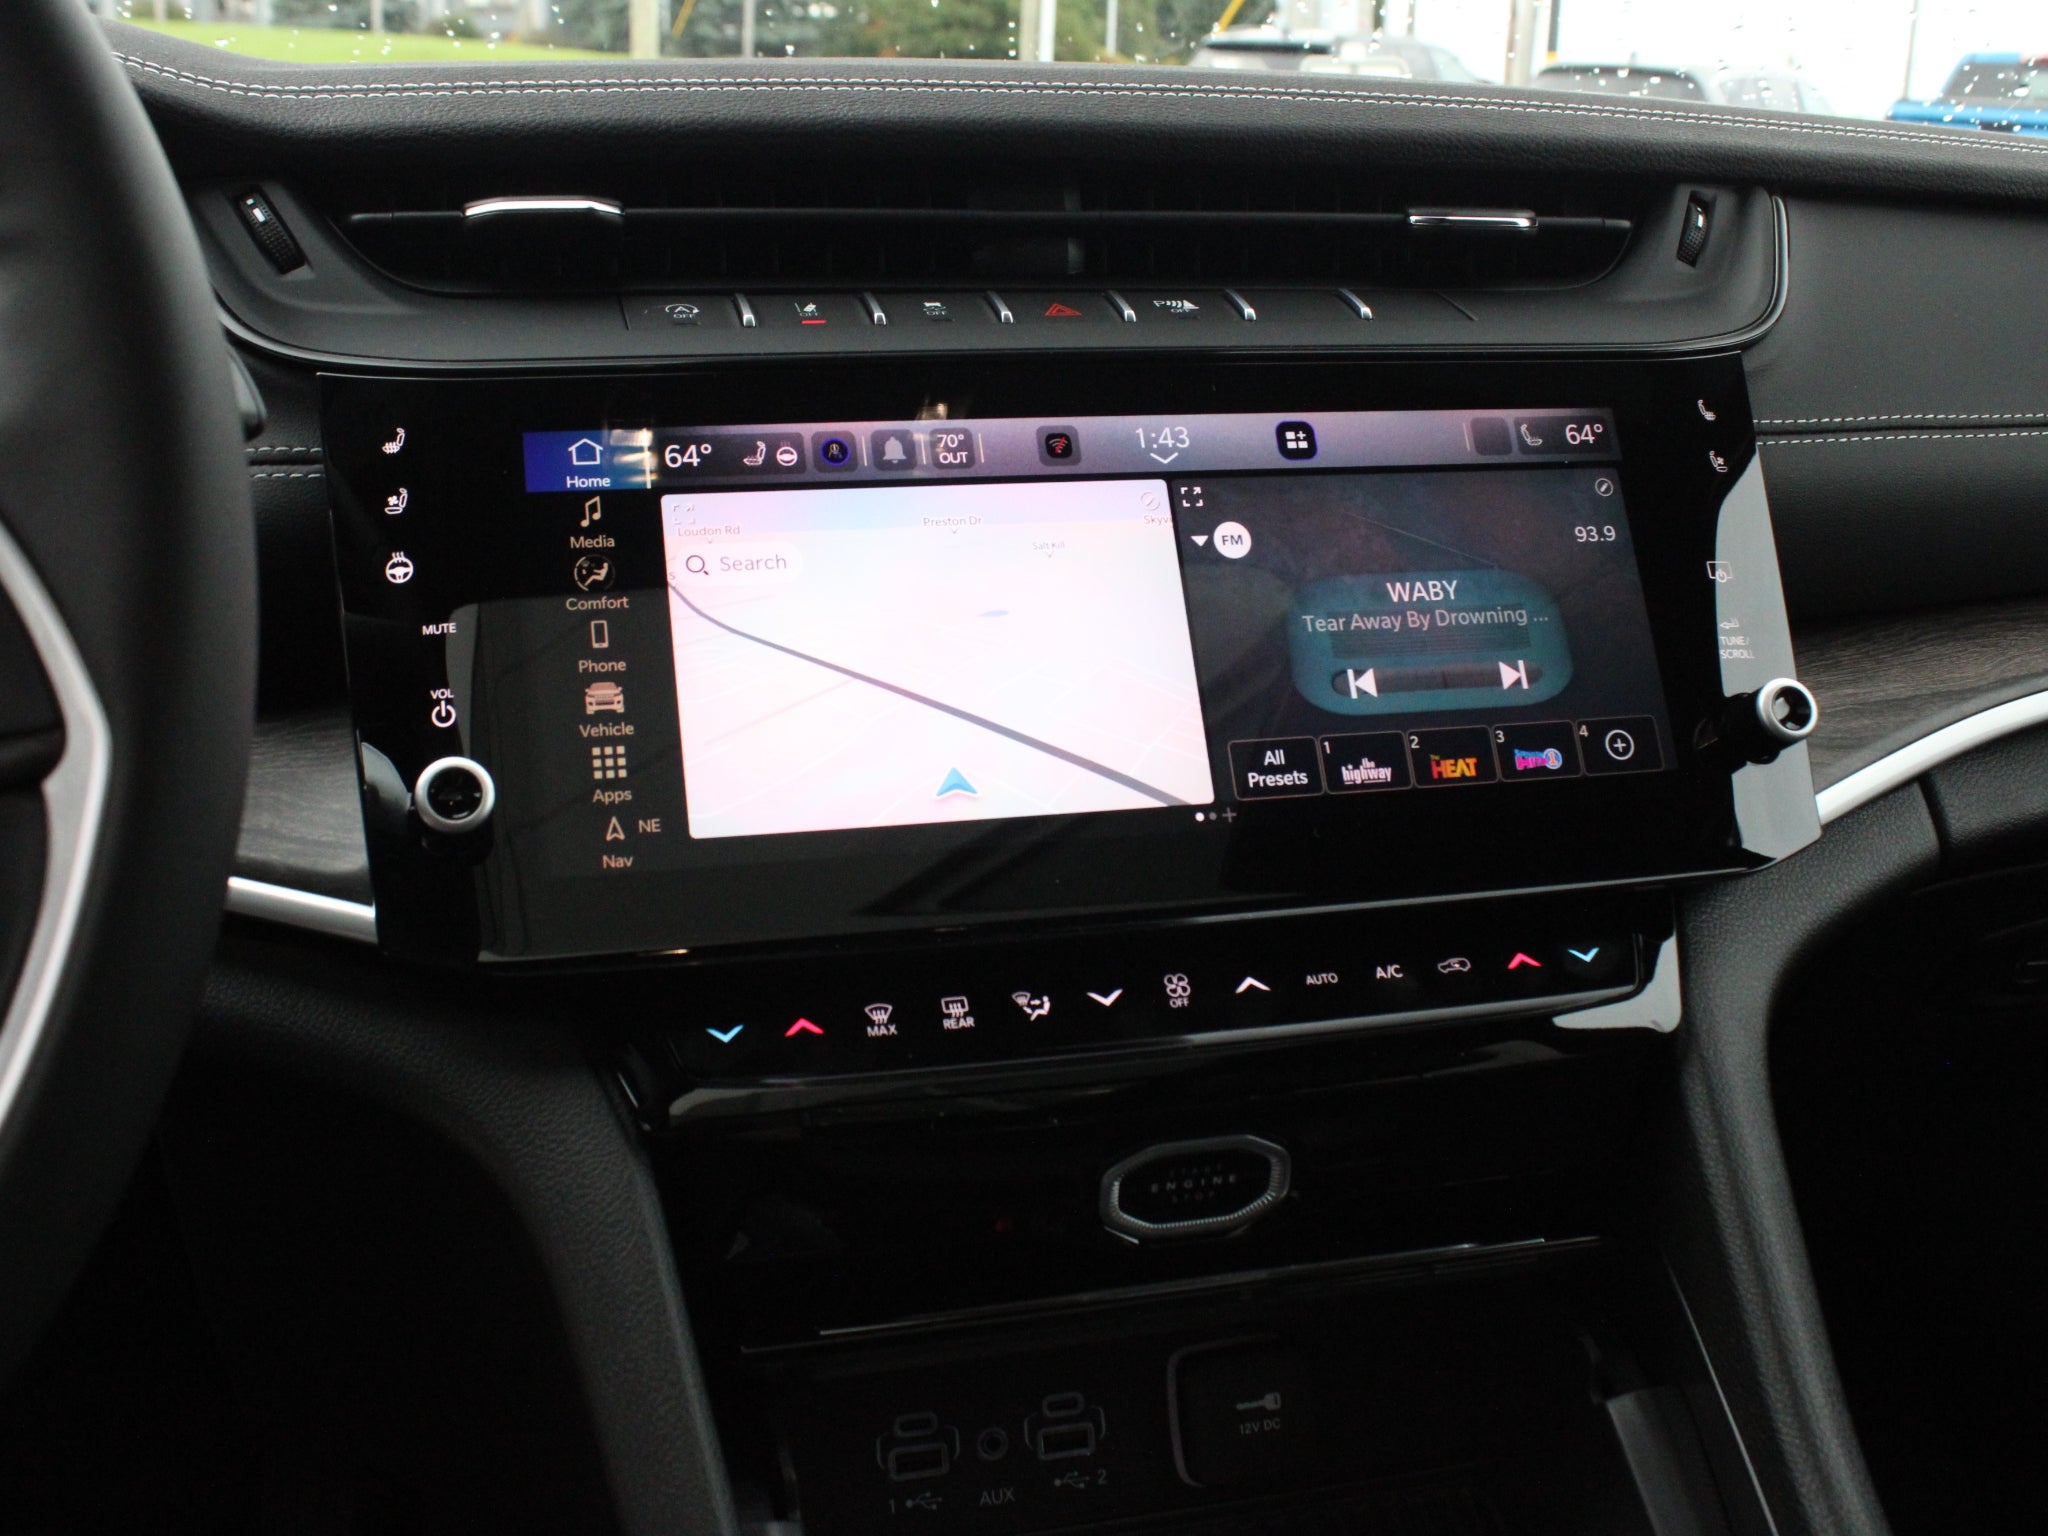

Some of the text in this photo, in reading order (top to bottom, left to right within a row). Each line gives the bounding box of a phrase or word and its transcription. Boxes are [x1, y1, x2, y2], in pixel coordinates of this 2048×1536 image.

[1136, 426, 1190, 449] 1:43
[939, 451, 968, 464] OUT
[566, 474, 611, 489] Home
[922, 515, 982, 527] Preston Dr
[678, 525, 741, 537] Loudon Rd
[1574, 525, 1616, 542] 93.9
[570, 534, 615, 549] Media
[1221, 534, 1243, 546] FM
[720, 555, 787, 572] Search
[1386, 580, 1458, 602] WABY
[566, 596, 629, 610] Comfort
[1302, 615, 1346, 632] Tear
[1350, 612, 1401, 632] Away
[1407, 611, 1430, 631] By
[1435, 607, 1528, 627] Drowning
[422, 622, 457, 636] MUTE
[1720, 649, 1755, 660] SCROLL
[578, 659, 627, 674] Phone
[430, 688, 454, 699] VOL
[579, 722, 634, 738] Vehicle
[1496, 730, 1505, 744] 3
[1579, 725, 1589, 738] 4
[1323, 741, 1331, 754] 1
[1410, 736, 1420, 749] 2
[1263, 749, 1286, 766] All
[1361, 757, 1375, 769] the
[1341, 763, 1392, 784] highway
[1430, 757, 1477, 779] HEAT
[1247, 770, 1309, 788] Presets
[592, 788, 633, 805] Apps
[638, 818, 661, 833] NE
[602, 854, 634, 869] Nav
[1305, 971, 1339, 986] AUTO
[1376, 964, 1403, 980] A/C
[1169, 997, 1190, 1009] OFF
[866, 1023, 897, 1038] MAX
[942, 1016, 975, 1031] REAR
[1151, 1173, 1238, 1194] ENGINE
[1239, 1418, 1281, 1435] 12V DC
[1097, 1469, 1108, 1485] 2
[979, 1487, 1016, 1506] AUX
